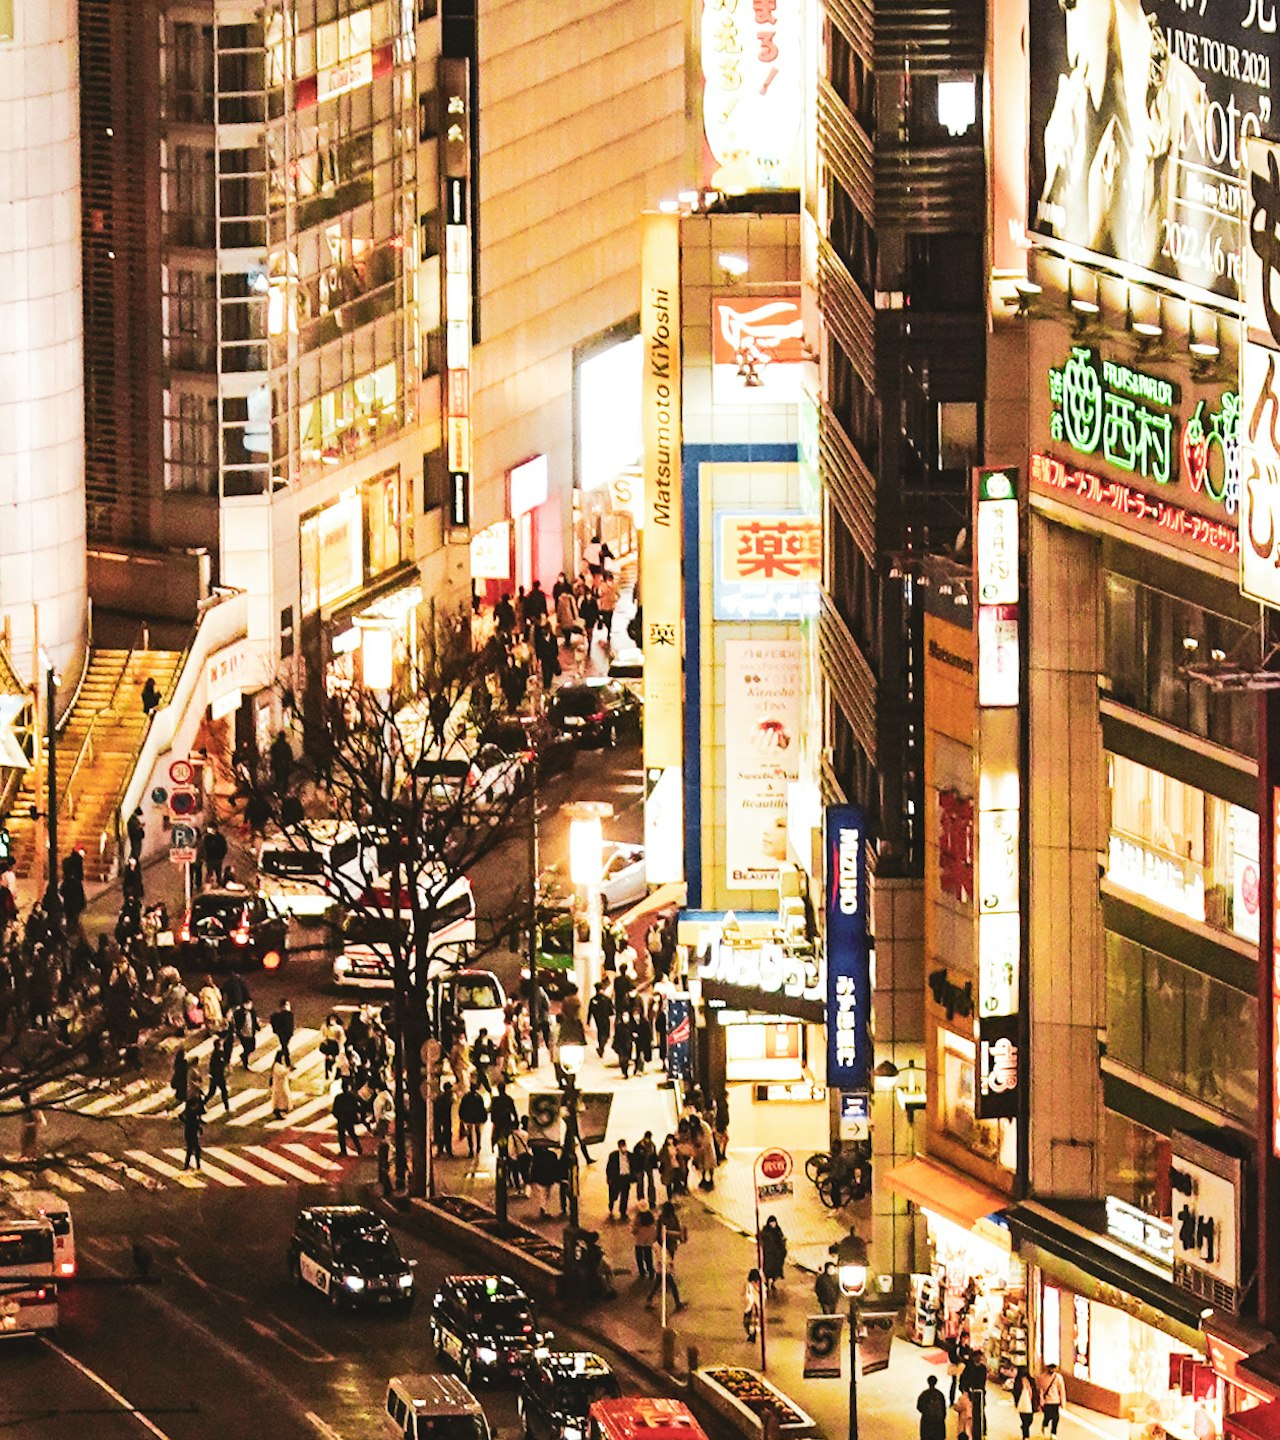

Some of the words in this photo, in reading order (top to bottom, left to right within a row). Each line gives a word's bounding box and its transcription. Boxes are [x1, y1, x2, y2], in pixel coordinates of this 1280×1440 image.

[1198, 35, 1241, 81] TOUR
[1241, 52, 1271, 89] 2021
[654, 382, 671, 527] Matsumoto
[1104, 391, 1173, 485] 西村
[650, 623, 676, 647] 薬
[839, 828, 859, 915] MIZUHO
